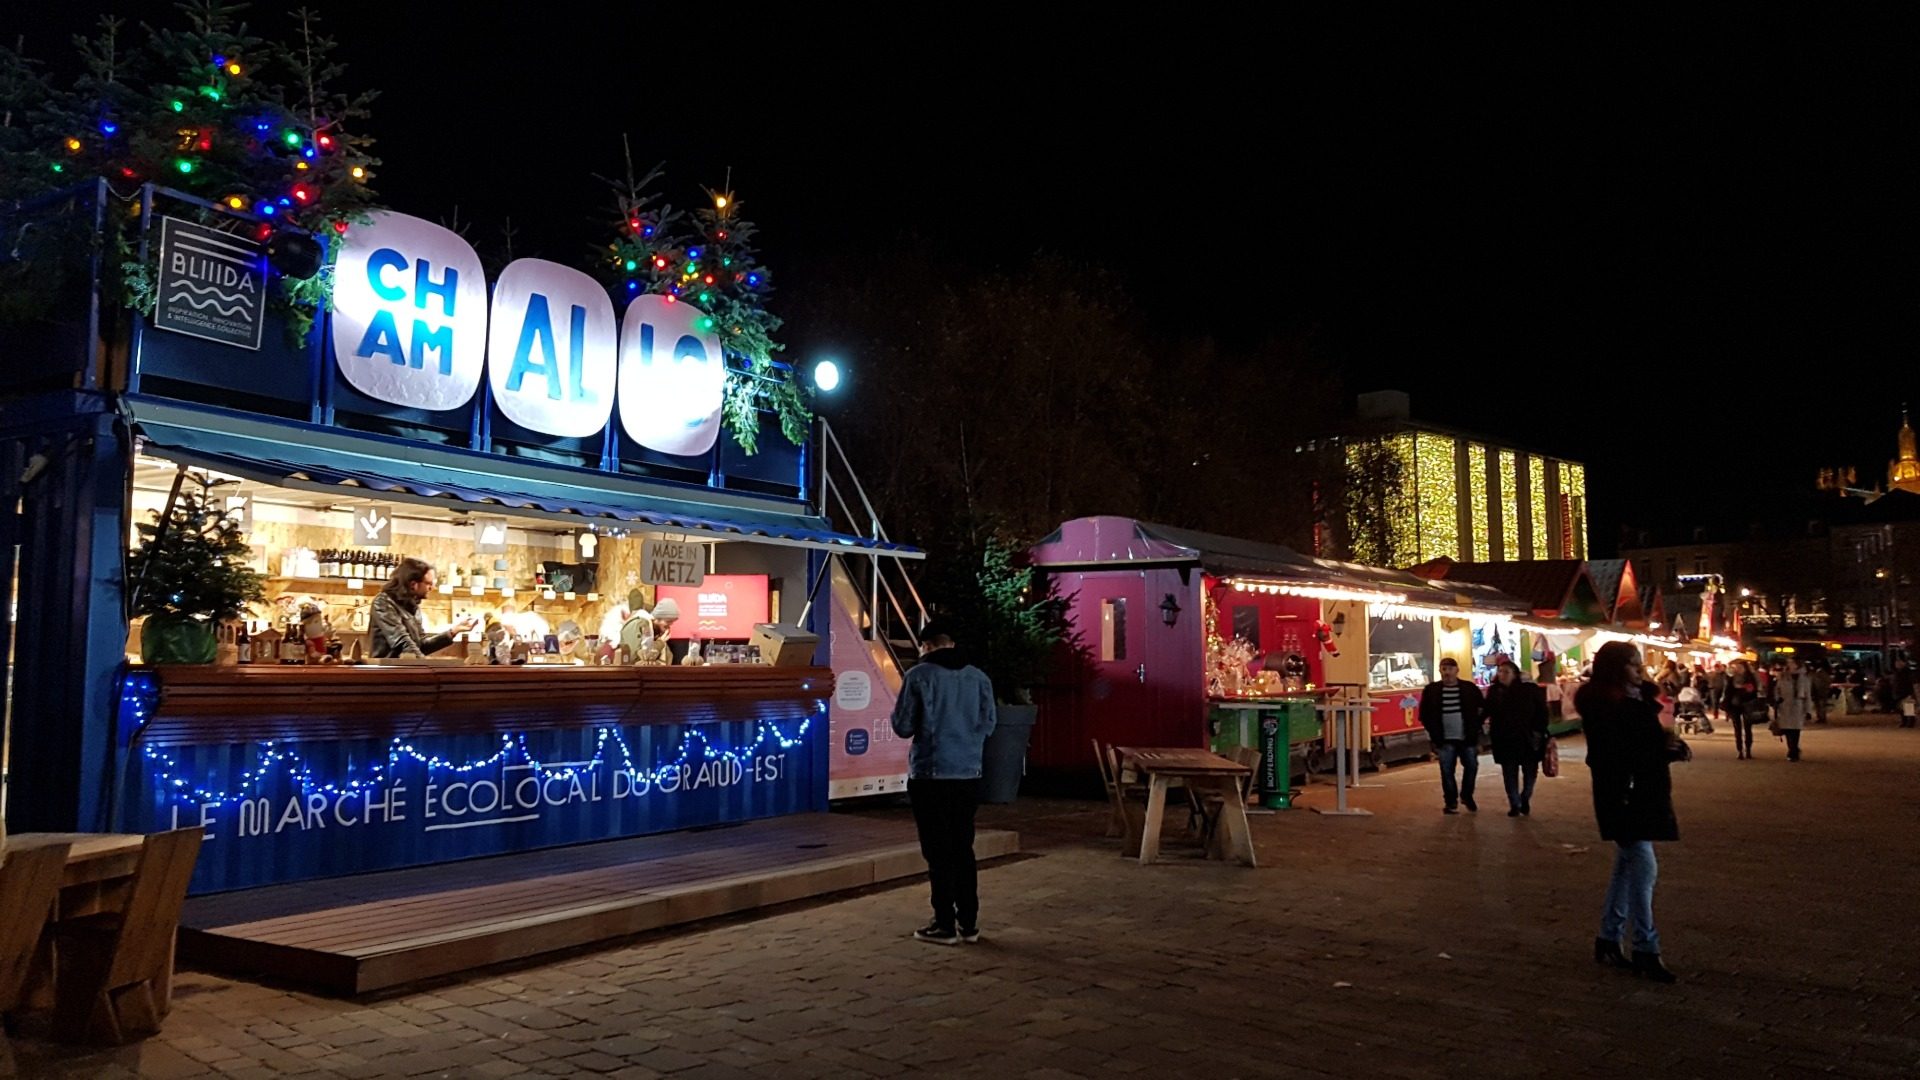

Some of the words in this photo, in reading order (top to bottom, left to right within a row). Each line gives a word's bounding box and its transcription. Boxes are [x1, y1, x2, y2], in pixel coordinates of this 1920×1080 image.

[171, 251, 255, 294] BLIIIDA
[366, 247, 458, 318] CH
[356, 309, 453, 376] AM
[650, 559, 696, 583] METZ
[651, 543, 683, 560] MADE
[686, 545, 698, 560] IN
[238, 777, 406, 837] MARCHÉ
[424, 766, 602, 818] ÉCOLOCAL
[612, 767, 651, 799] DU
[658, 754, 785, 793] GRAND-EST
